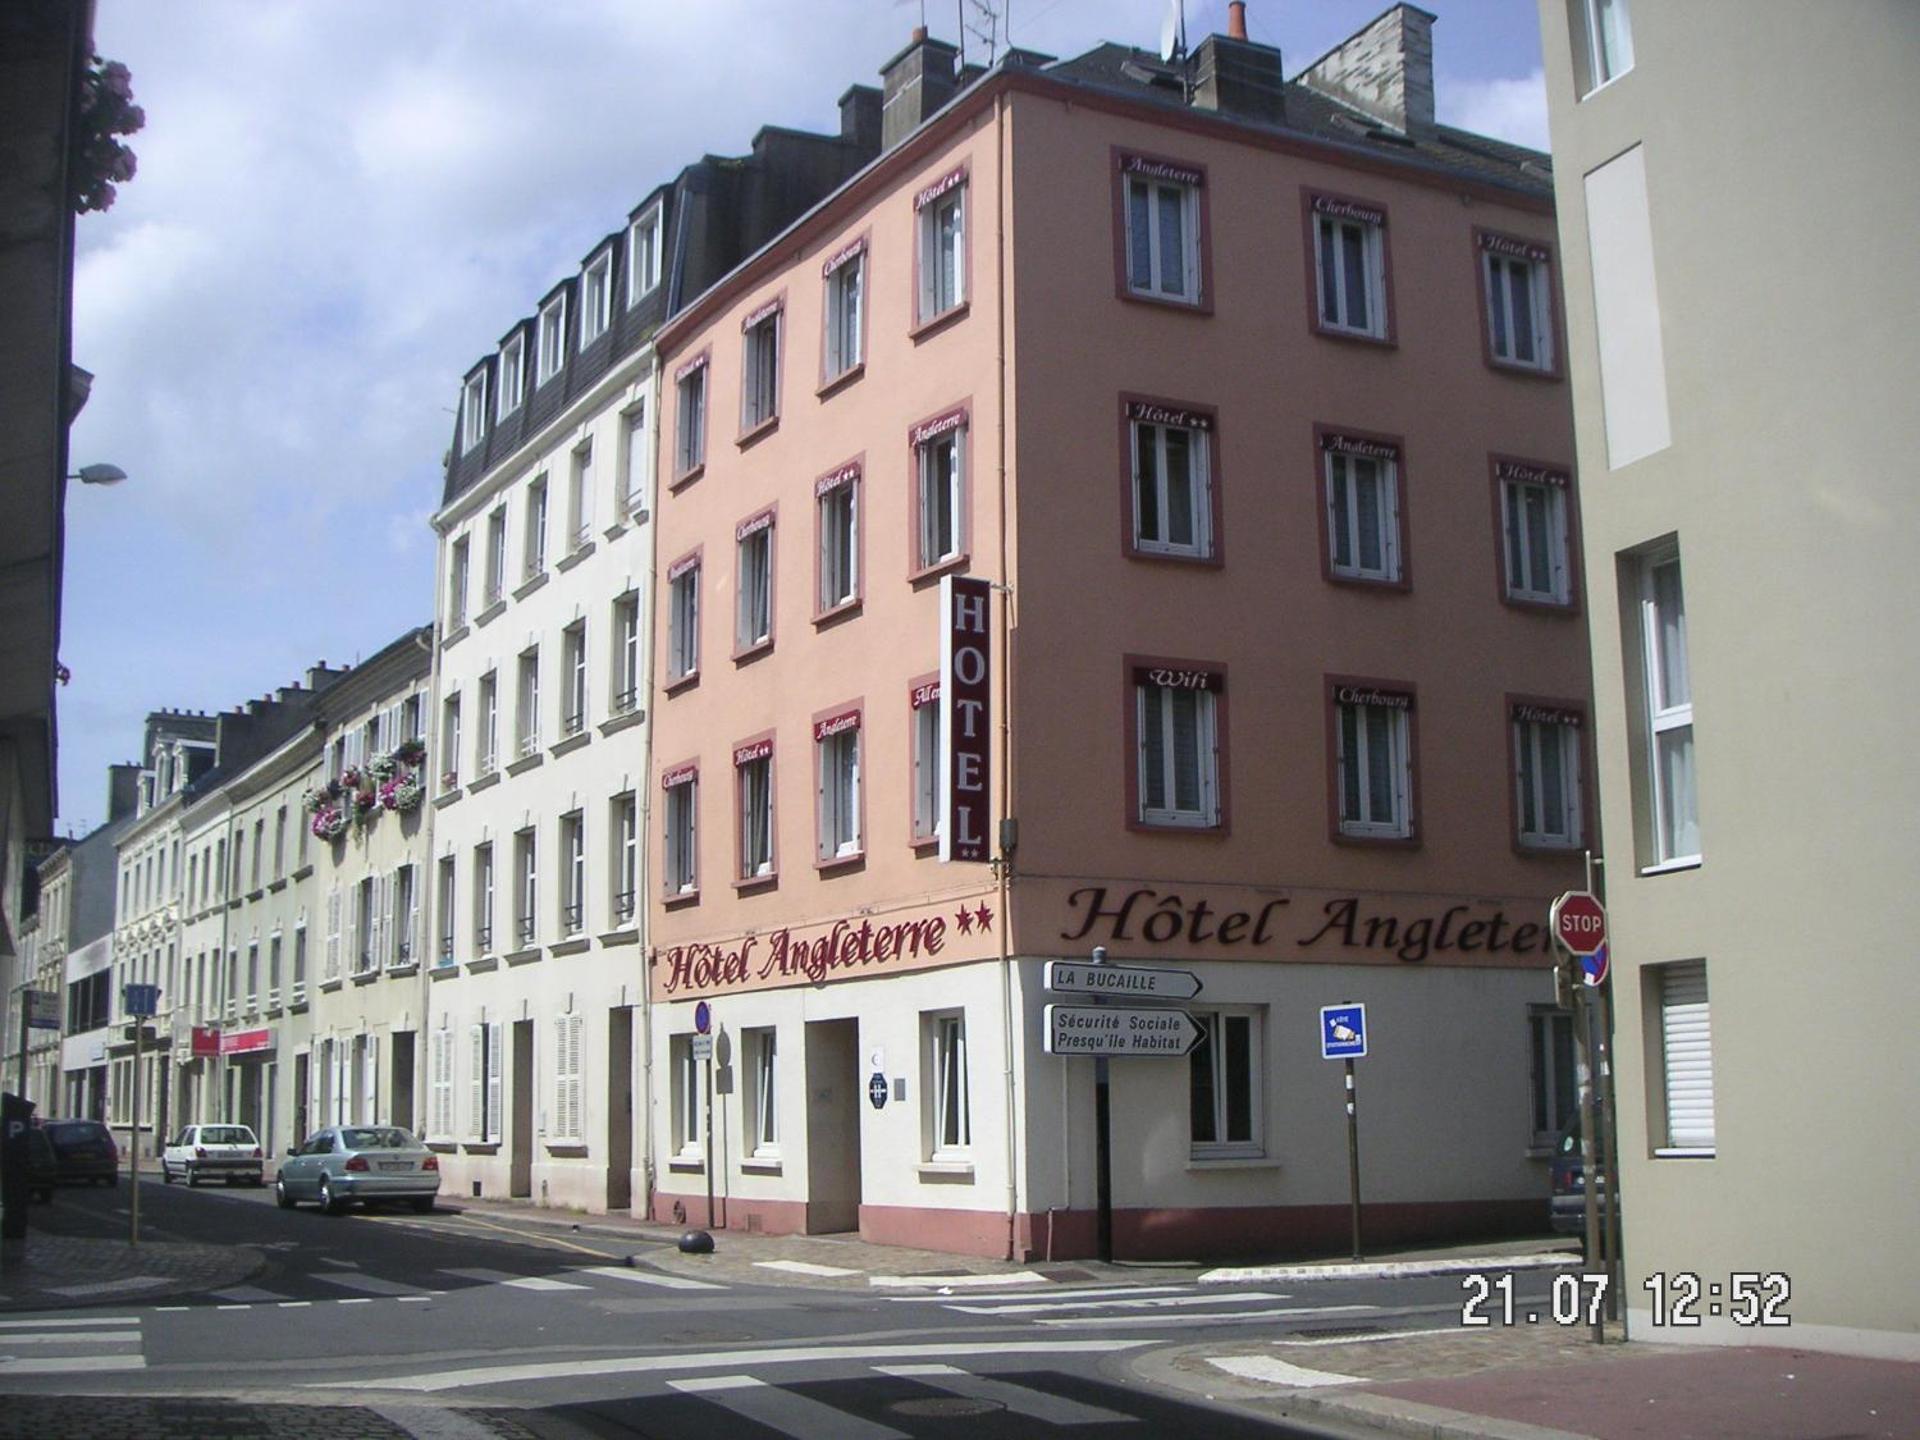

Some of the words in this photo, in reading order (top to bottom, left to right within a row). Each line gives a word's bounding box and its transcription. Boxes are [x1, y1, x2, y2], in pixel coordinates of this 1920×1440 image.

[1149, 668, 1209, 690] Wifi
[953, 593, 986, 845] HOTEL
[1060, 887, 1294, 947] Hôtel
[1298, 897, 1551, 962] Angleter
[1561, 914, 1602, 932] STOP
[664, 935, 757, 994] Hôtel
[758, 915, 947, 983] Angleterre
[1058, 971, 1075, 985] LA
[1086, 973, 1156, 991] BUCAILLE
[1058, 1013, 1120, 1030] Sécurité
[1129, 1015, 1181, 1031] Sociale
[1132, 1033, 1181, 1050] Habitat
